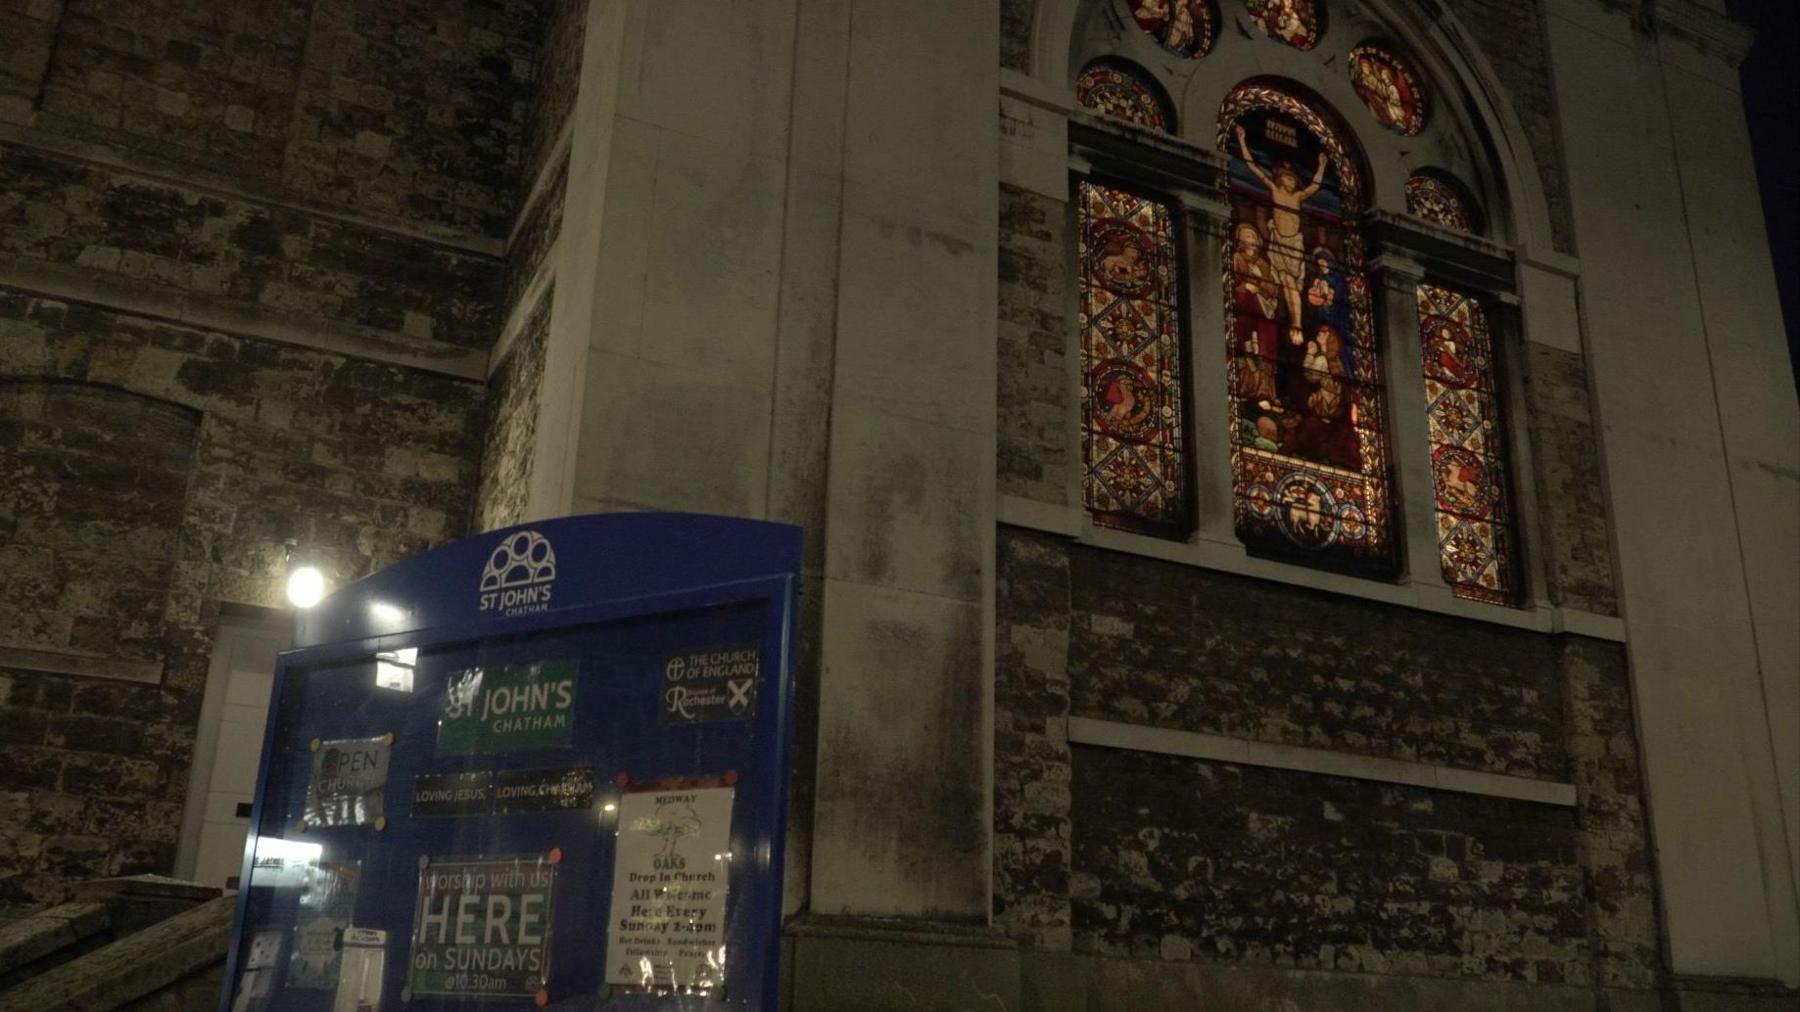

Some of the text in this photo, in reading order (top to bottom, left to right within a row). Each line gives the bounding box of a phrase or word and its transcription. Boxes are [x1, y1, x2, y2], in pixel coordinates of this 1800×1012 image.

[480, 584, 552, 611] ST JOHN'S
[506, 603, 548, 617] CHATHAM
[689, 650, 756, 667] THE CHURCH
[687, 663, 755, 679] OF ENGLAND
[481, 680, 573, 721] JOHN'S
[665, 685, 728, 719] Rochester
[492, 714, 567, 734] CHATHAM
[323, 749, 380, 775] PEN
[416, 789, 452, 803] LOVING
[656, 794, 698, 804] MEDWAY
[653, 857, 686, 870] OAKS
[491, 867, 526, 888] with
[629, 871, 716, 884] Drop In Church
[630, 888, 712, 900] All Wcme
[419, 894, 545, 945] HERE
[415, 948, 541, 971] on SUNDAYS
